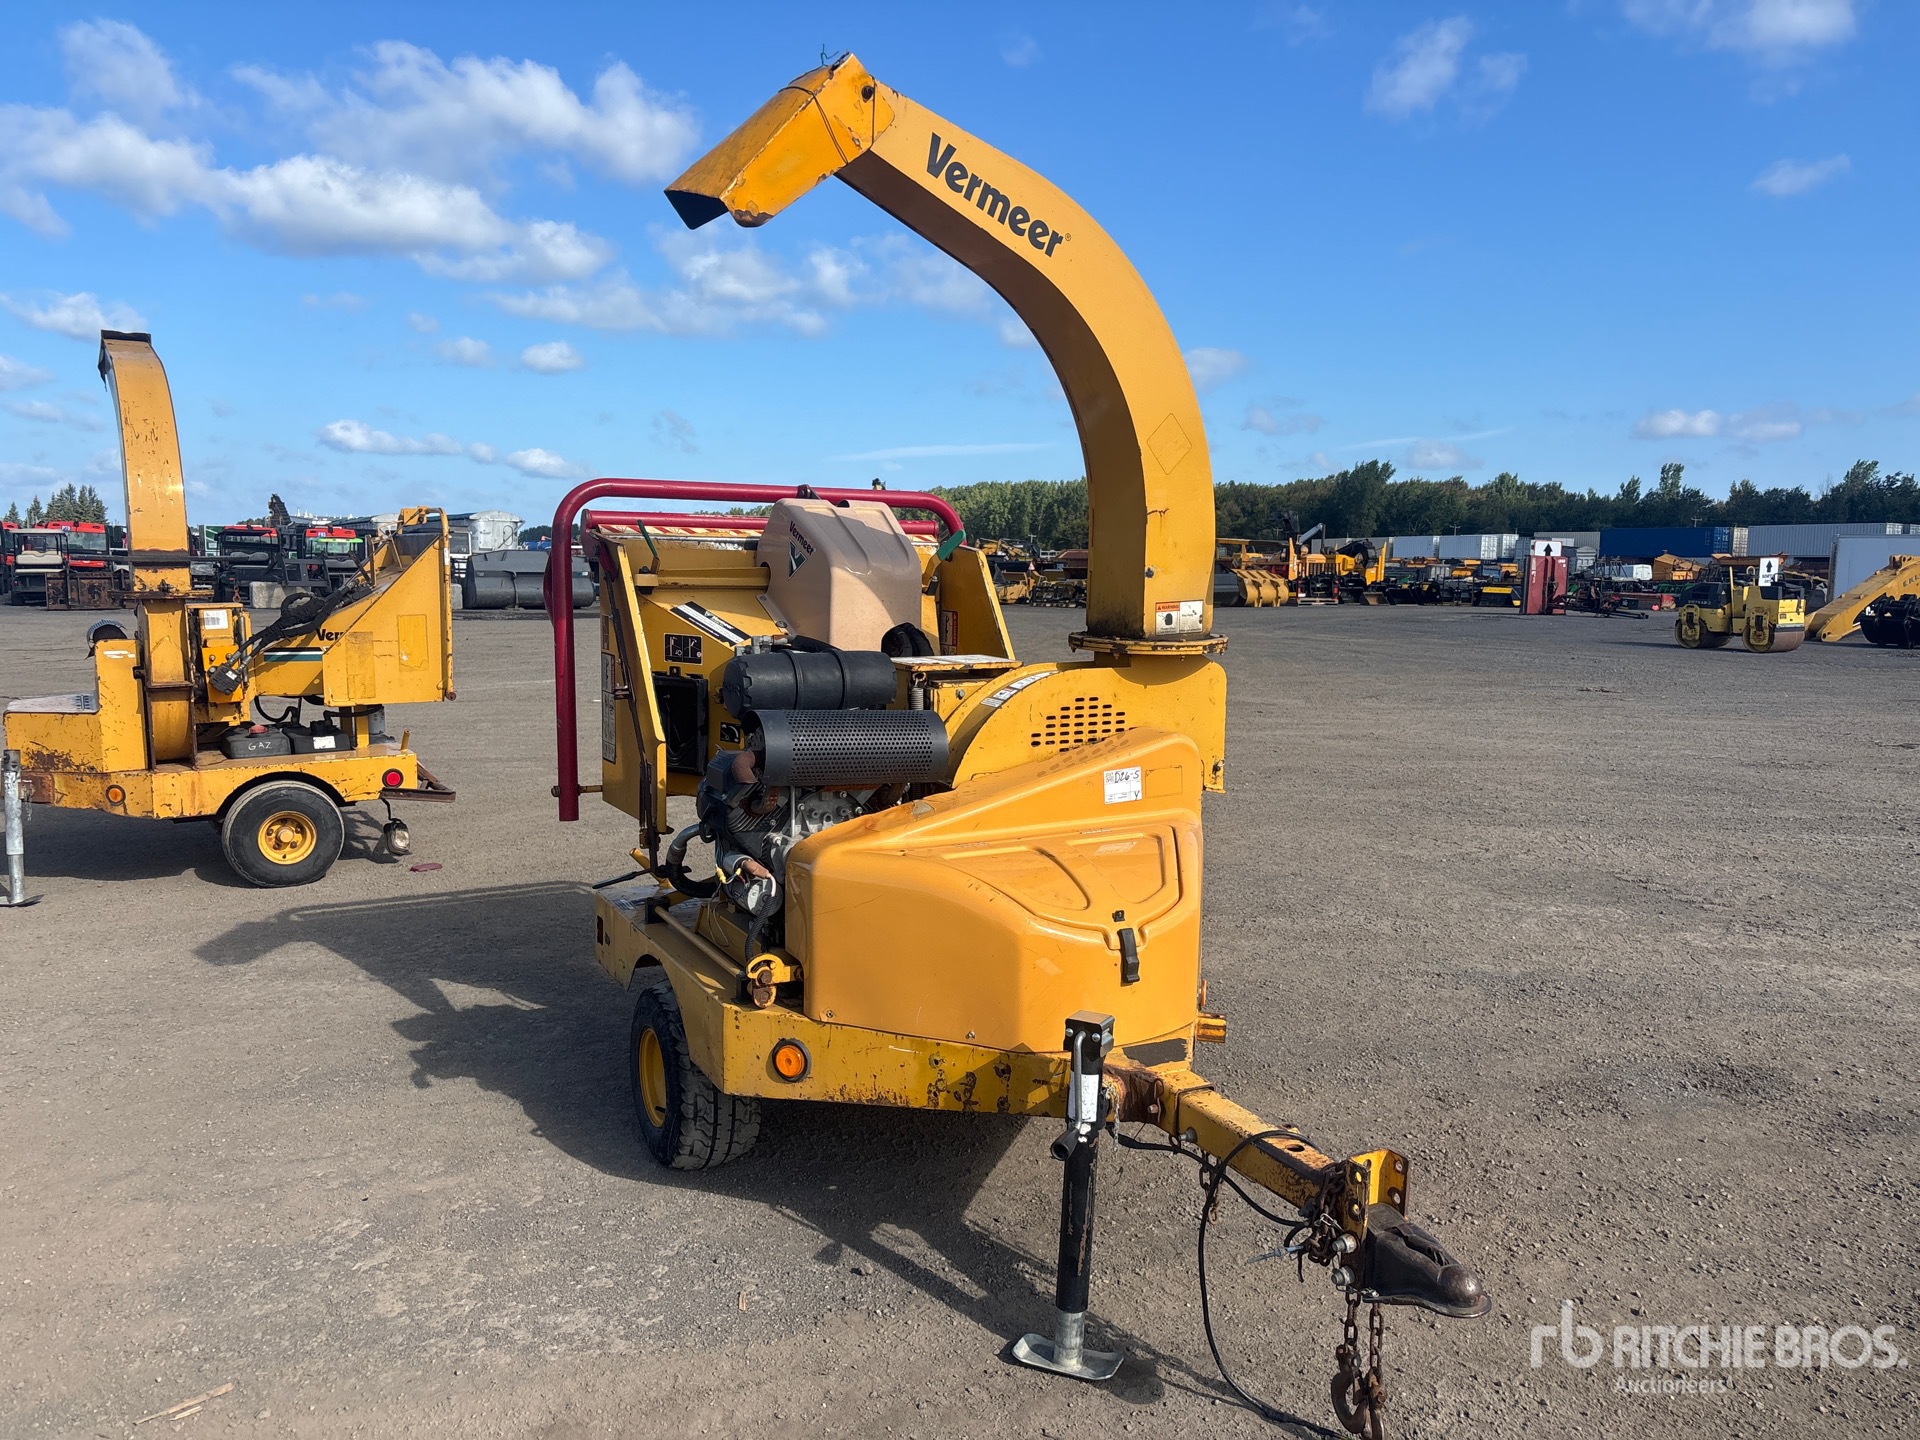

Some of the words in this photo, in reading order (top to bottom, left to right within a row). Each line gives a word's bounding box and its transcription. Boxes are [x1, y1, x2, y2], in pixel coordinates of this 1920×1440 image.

[926, 131, 1064, 258] Vermeer
[788, 520, 815, 556] Vermeer
[316, 628, 344, 641] Ver
[248, 741, 272, 751] GAZ
